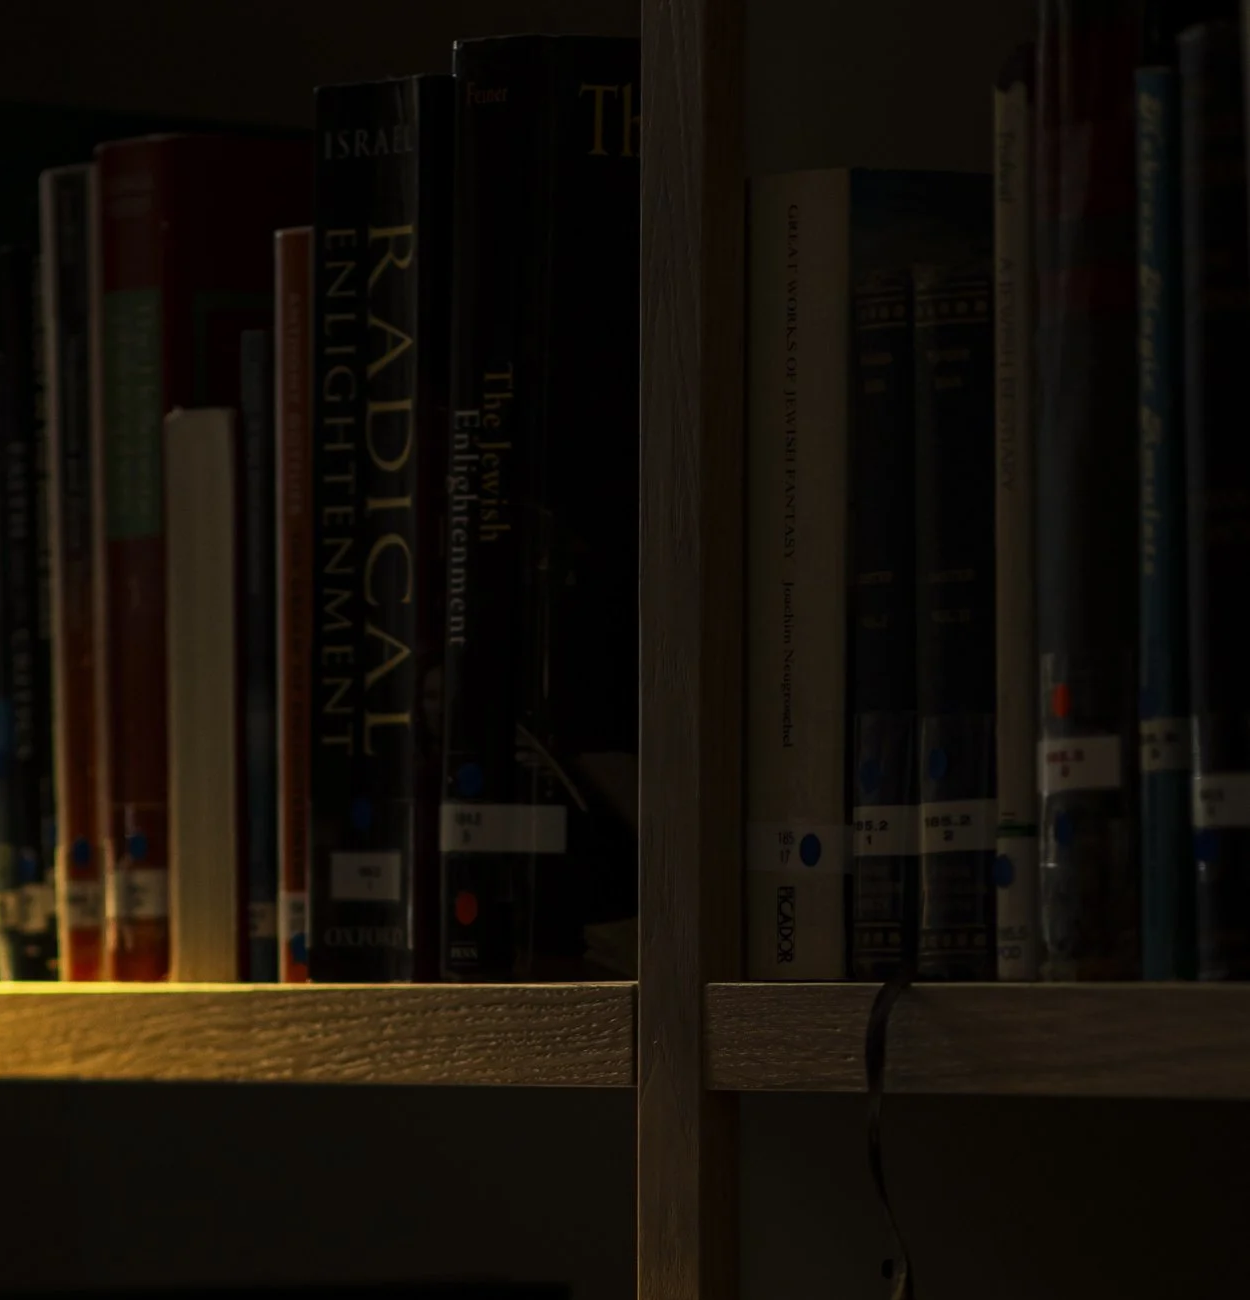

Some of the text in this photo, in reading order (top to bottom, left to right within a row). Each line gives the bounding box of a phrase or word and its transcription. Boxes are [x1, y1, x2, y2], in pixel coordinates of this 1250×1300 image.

[324, 126, 415, 160] ISRAEL
[320, 227, 358, 758] ENLIGHTENMENT
[363, 222, 416, 758] RADICAL
[444, 409, 481, 648] Enlightenment
[475, 361, 515, 543] The Jewish
[780, 204, 799, 749] GREAT WORKS OF JEWISH FANTASY Joachim Neugroschel
[777, 886, 796, 964] PICADOR
[853, 820, 889, 832] 85.2
